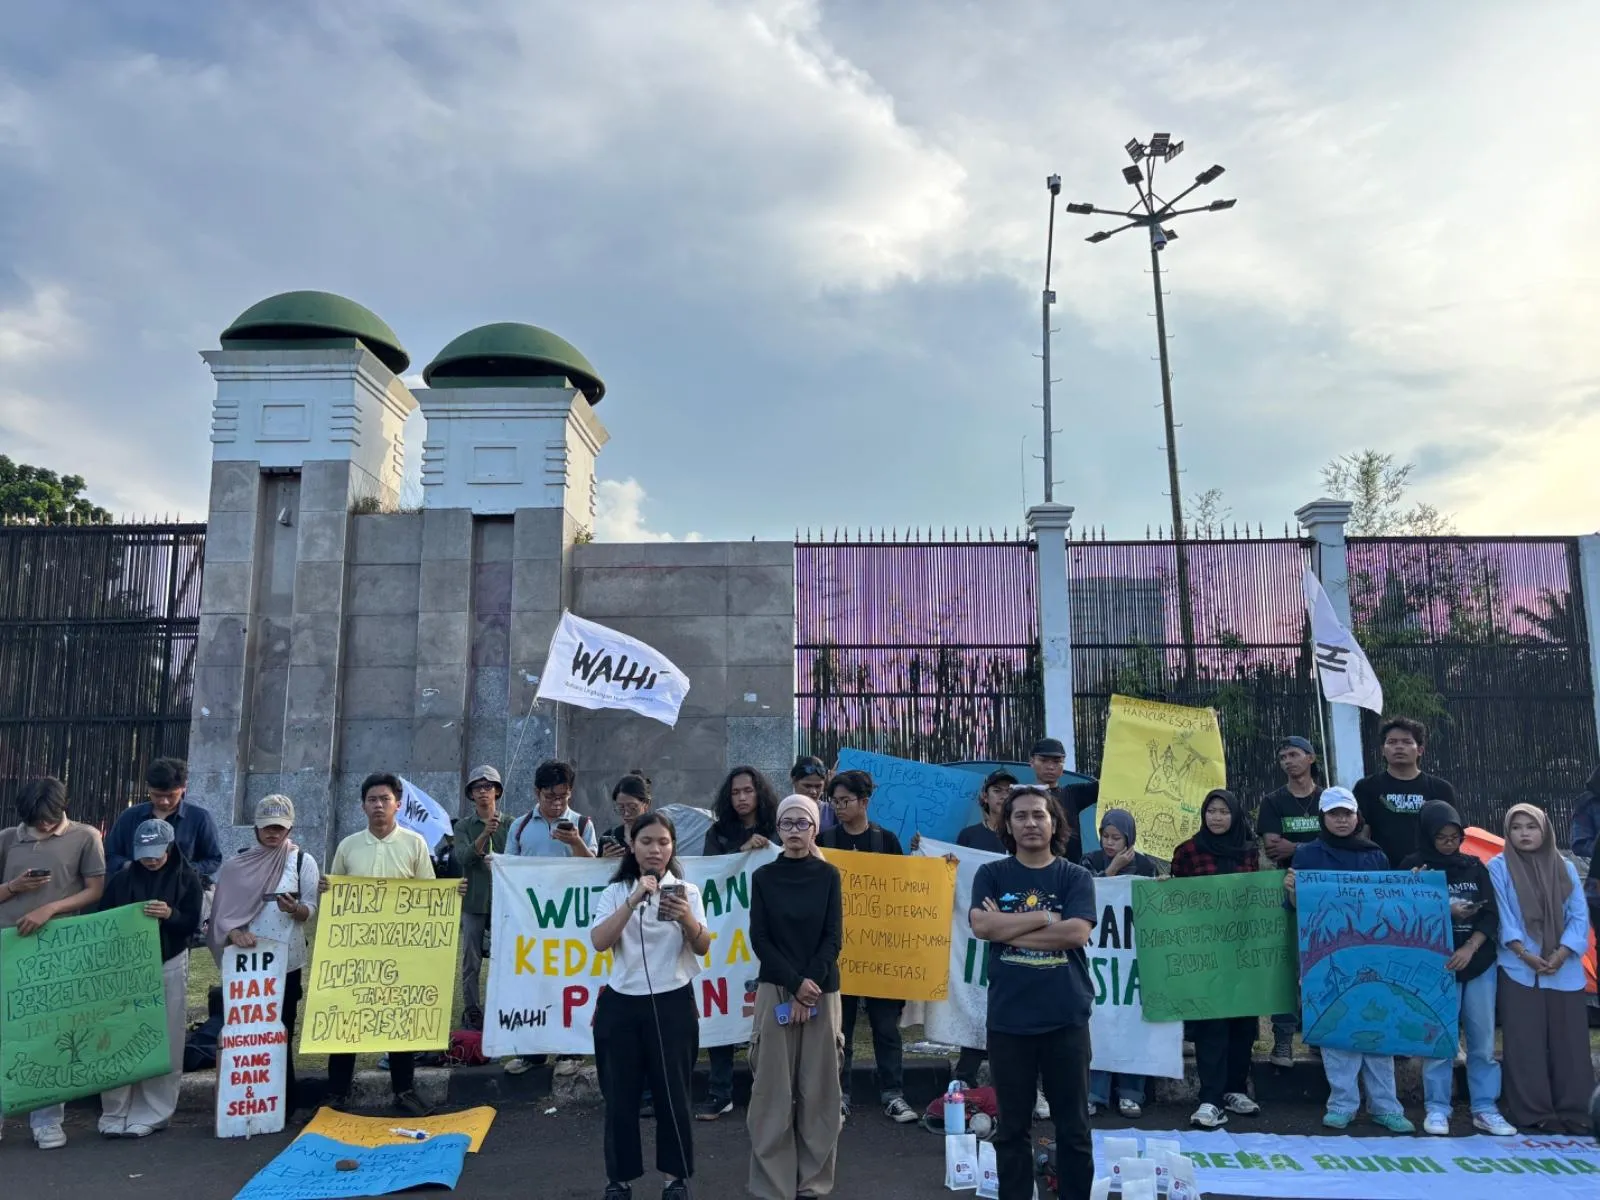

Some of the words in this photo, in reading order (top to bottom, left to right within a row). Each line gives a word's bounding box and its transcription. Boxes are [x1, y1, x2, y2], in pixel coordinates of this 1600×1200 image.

[1123, 707, 1166, 722] HANCUR
[1407, 794, 1424, 802] FOR
[850, 873, 887, 893] PATAH
[892, 877, 930, 895] TUMBUH
[1299, 872, 1326, 883] SATU
[1378, 873, 1425, 885] LESTARI
[395, 885, 456, 916] BUMI
[1335, 887, 1366, 898] JAGA
[1374, 887, 1405, 898] BUMI
[1413, 888, 1443, 900] KITA
[885, 903, 938, 920] DITEBANG
[37, 918, 120, 947] KATANYA
[328, 922, 454, 949] DIRAYAKAN
[236, 951, 275, 973] RIP
[848, 959, 927, 981] DEFORESTASI
[1166, 952, 1219, 978] BUMI
[317, 958, 399, 991] LUBANG
[229, 977, 277, 1000] HAK
[353, 985, 439, 1006] TAMBANG
[227, 1002, 278, 1026] ATAS
[232, 1052, 271, 1068] YANG
[231, 1069, 270, 1086] BAIK
[245, 1086, 255, 1098] &
[226, 1096, 278, 1116] SEHAT
[1312, 1153, 1448, 1174] BUMI
